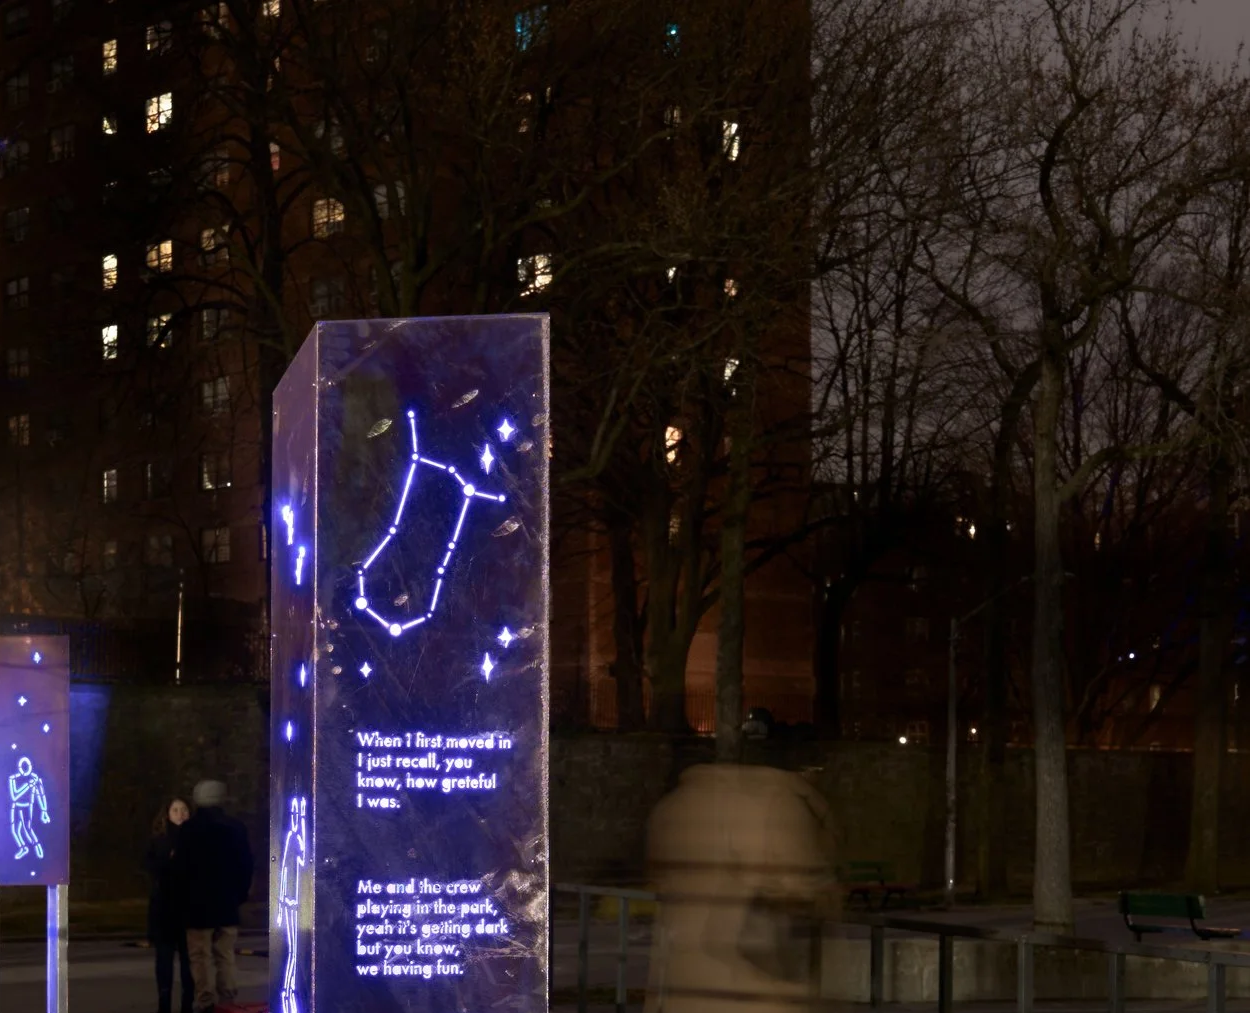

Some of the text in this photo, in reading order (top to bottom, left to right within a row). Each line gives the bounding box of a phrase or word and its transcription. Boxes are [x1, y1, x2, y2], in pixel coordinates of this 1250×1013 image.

[357, 732, 401, 747] When
[416, 732, 442, 748] first
[446, 734, 494, 749] moved
[499, 736, 511, 749] in
[367, 754, 391, 771] just
[396, 753, 440, 770] recall,
[445, 758, 472, 772] you
[357, 772, 402, 790] know,
[406, 773, 437, 788] how
[367, 798, 401, 808] was.
[358, 878, 481, 894] Me and the crew
[357, 899, 498, 918] playing in the park,
[357, 918, 508, 938] yeah it's getting dark
[357, 939, 460, 958] but you know,
[357, 960, 464, 978] we having fun.
